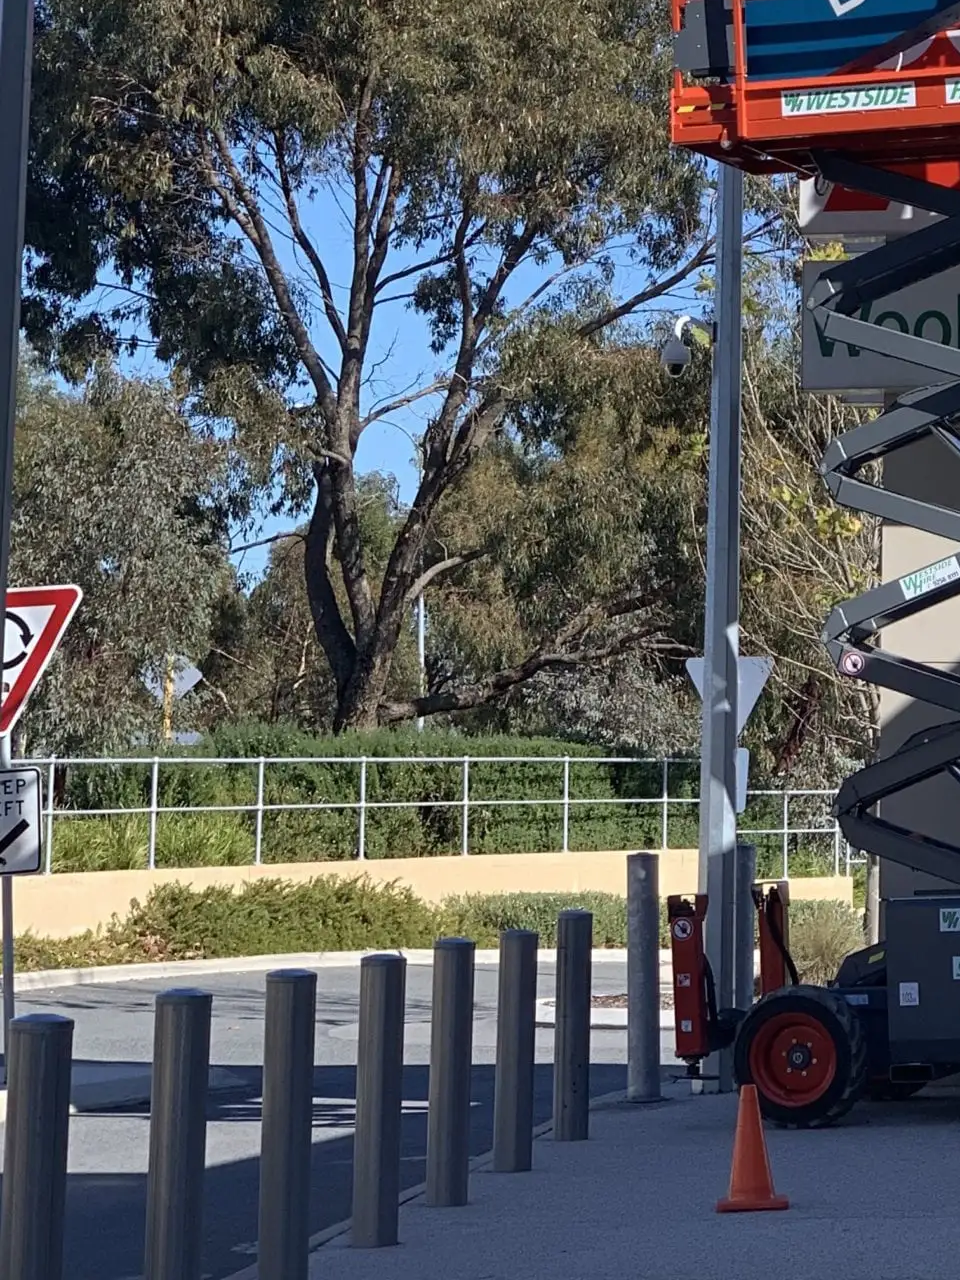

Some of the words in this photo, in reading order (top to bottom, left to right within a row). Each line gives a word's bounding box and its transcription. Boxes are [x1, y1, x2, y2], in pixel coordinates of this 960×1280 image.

[806, 84, 912, 111] WESTSIDE
[0, 779, 26, 795] EP
[0, 800, 24, 816] FT
